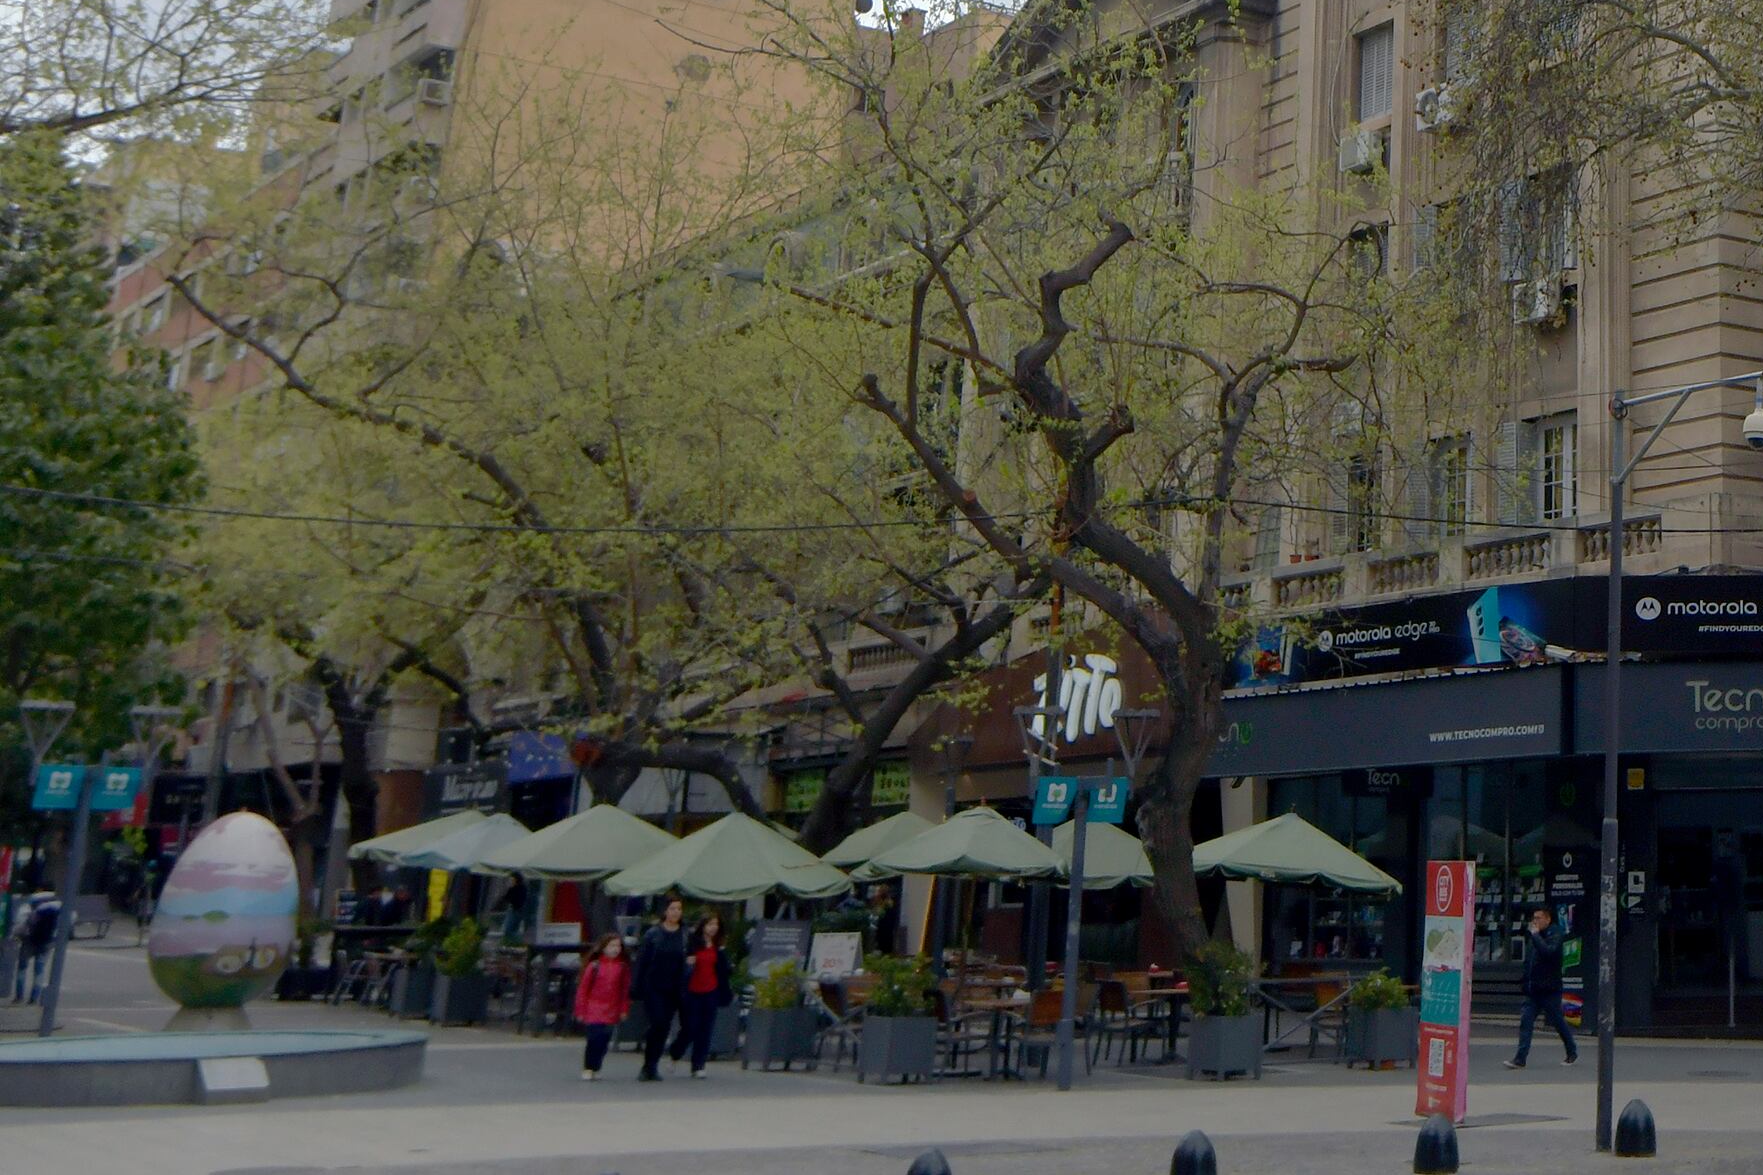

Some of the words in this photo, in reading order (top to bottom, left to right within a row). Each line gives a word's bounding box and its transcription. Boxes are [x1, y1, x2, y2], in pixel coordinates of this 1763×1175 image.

[1667, 600, 1757, 615] motorola
[1335, 627, 1392, 645] motorola
[1395, 621, 1427, 641] edge
